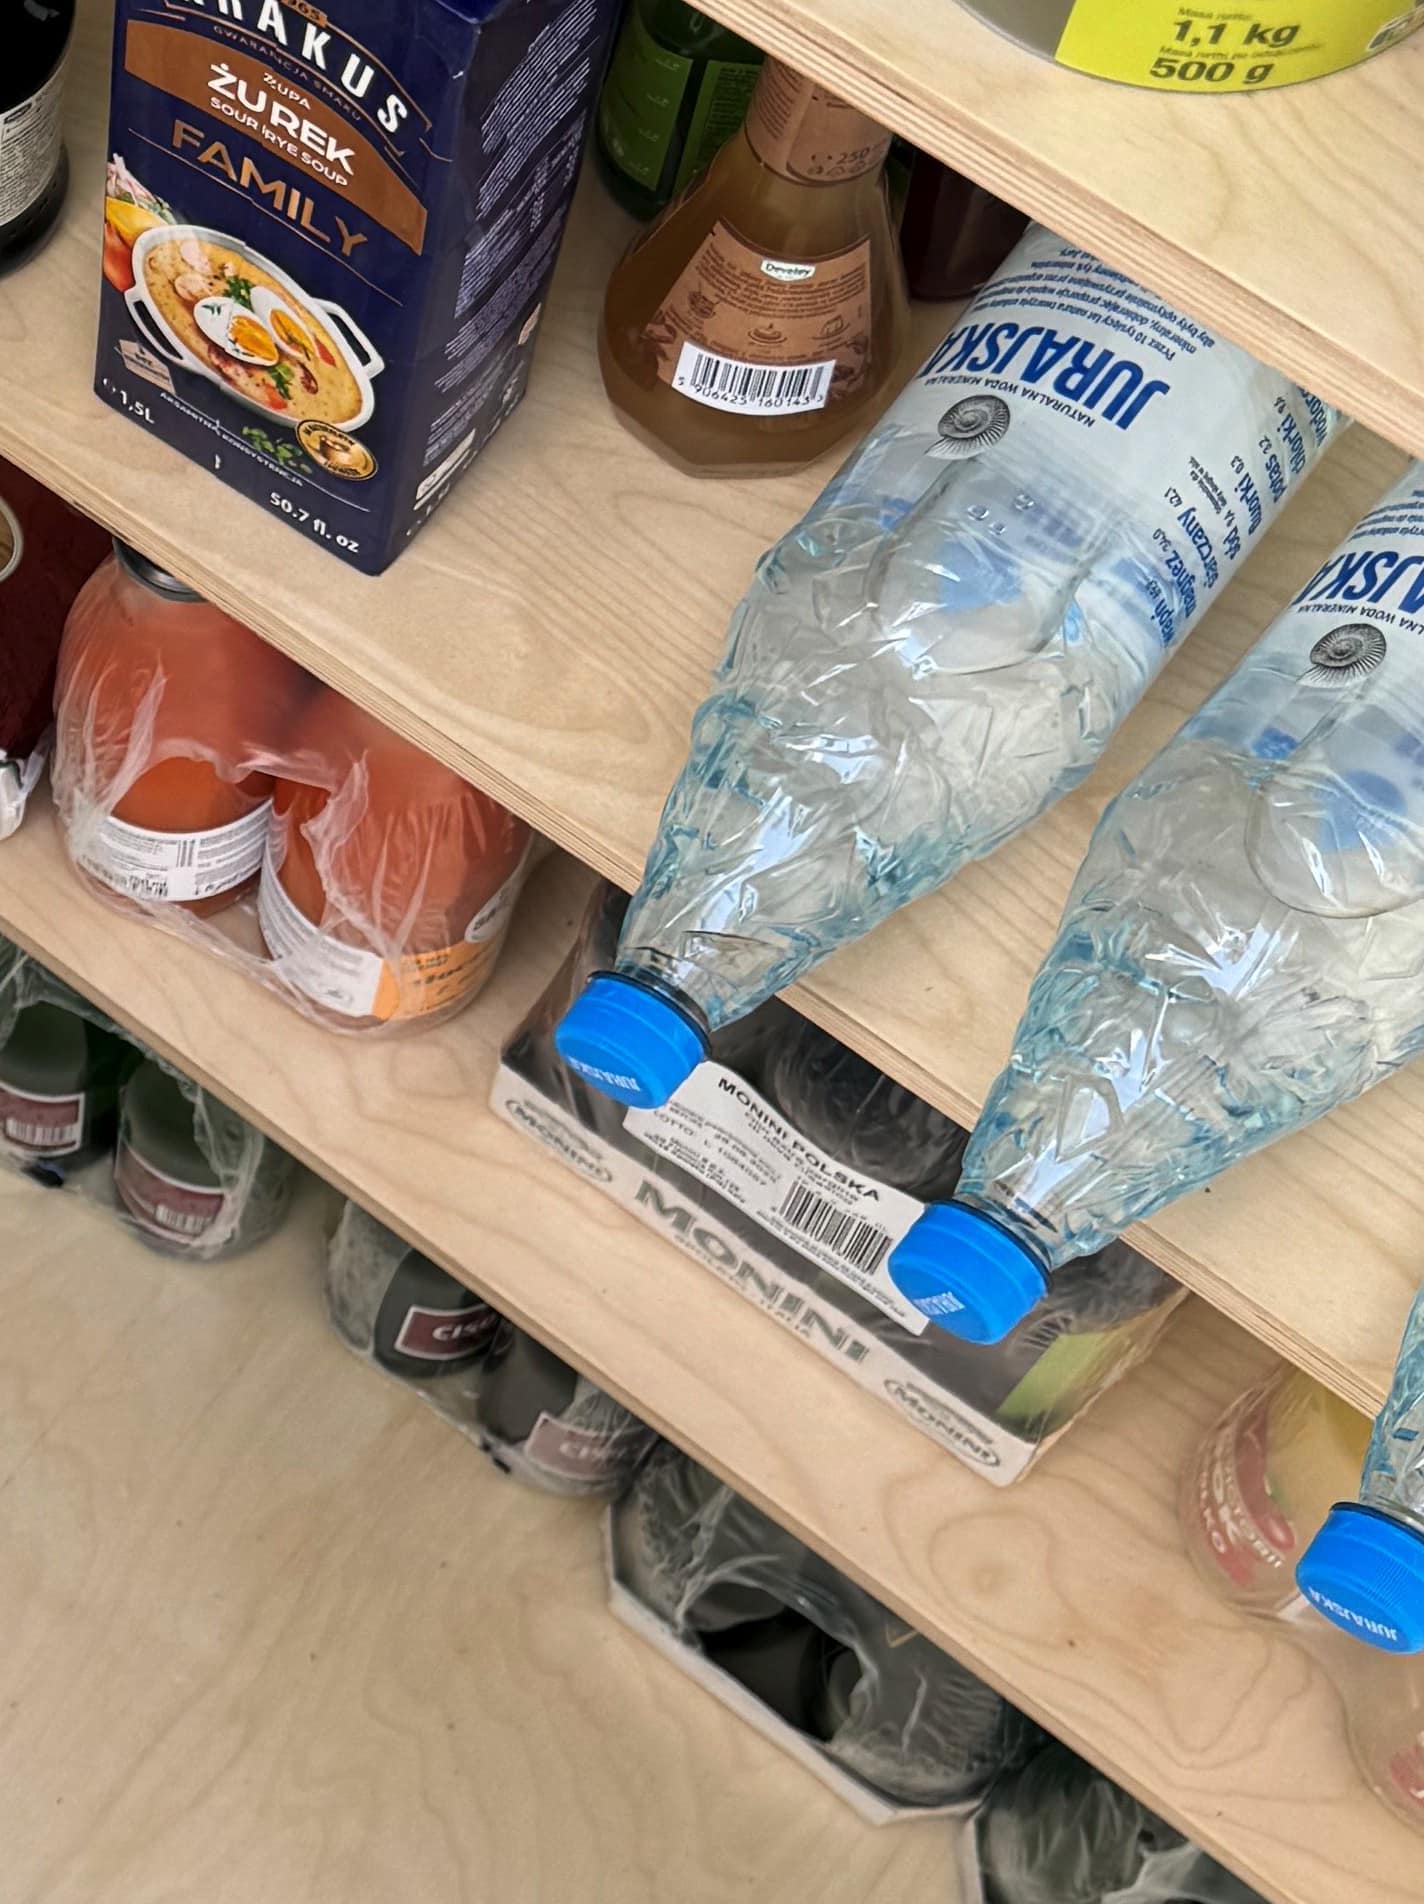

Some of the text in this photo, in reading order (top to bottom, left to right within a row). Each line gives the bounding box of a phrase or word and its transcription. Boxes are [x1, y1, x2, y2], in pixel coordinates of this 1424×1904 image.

[212, 23, 310, 82] GWARANCJA
[1149, 56, 1276, 85] 500 g
[1172, 19, 1302, 50] 1,1 kg
[206, 61, 358, 176] ŻUREK
[263, 71, 312, 111] ZUPA
[208, 95, 260, 134] SOUR
[299, 150, 350, 188] SOUP
[171, 118, 369, 258] FAMILY
[764, 261, 813, 278] Develey
[916, 320, 1171, 432] JURAJSKA
[990, 376, 1020, 396] WODA
[1019, 383, 1097, 429] NATURALNA
[268, 491, 361, 554] 50.7 oz
[1177, 506, 1222, 589] siarczany
[1162, 545, 1199, 621] magnez
[717, 1076, 789, 1146] MONINI
[790, 1138, 882, 1203] POLSKA
[634, 1177, 871, 1365] MONINI
[894, 1386, 993, 1464] MONINI
